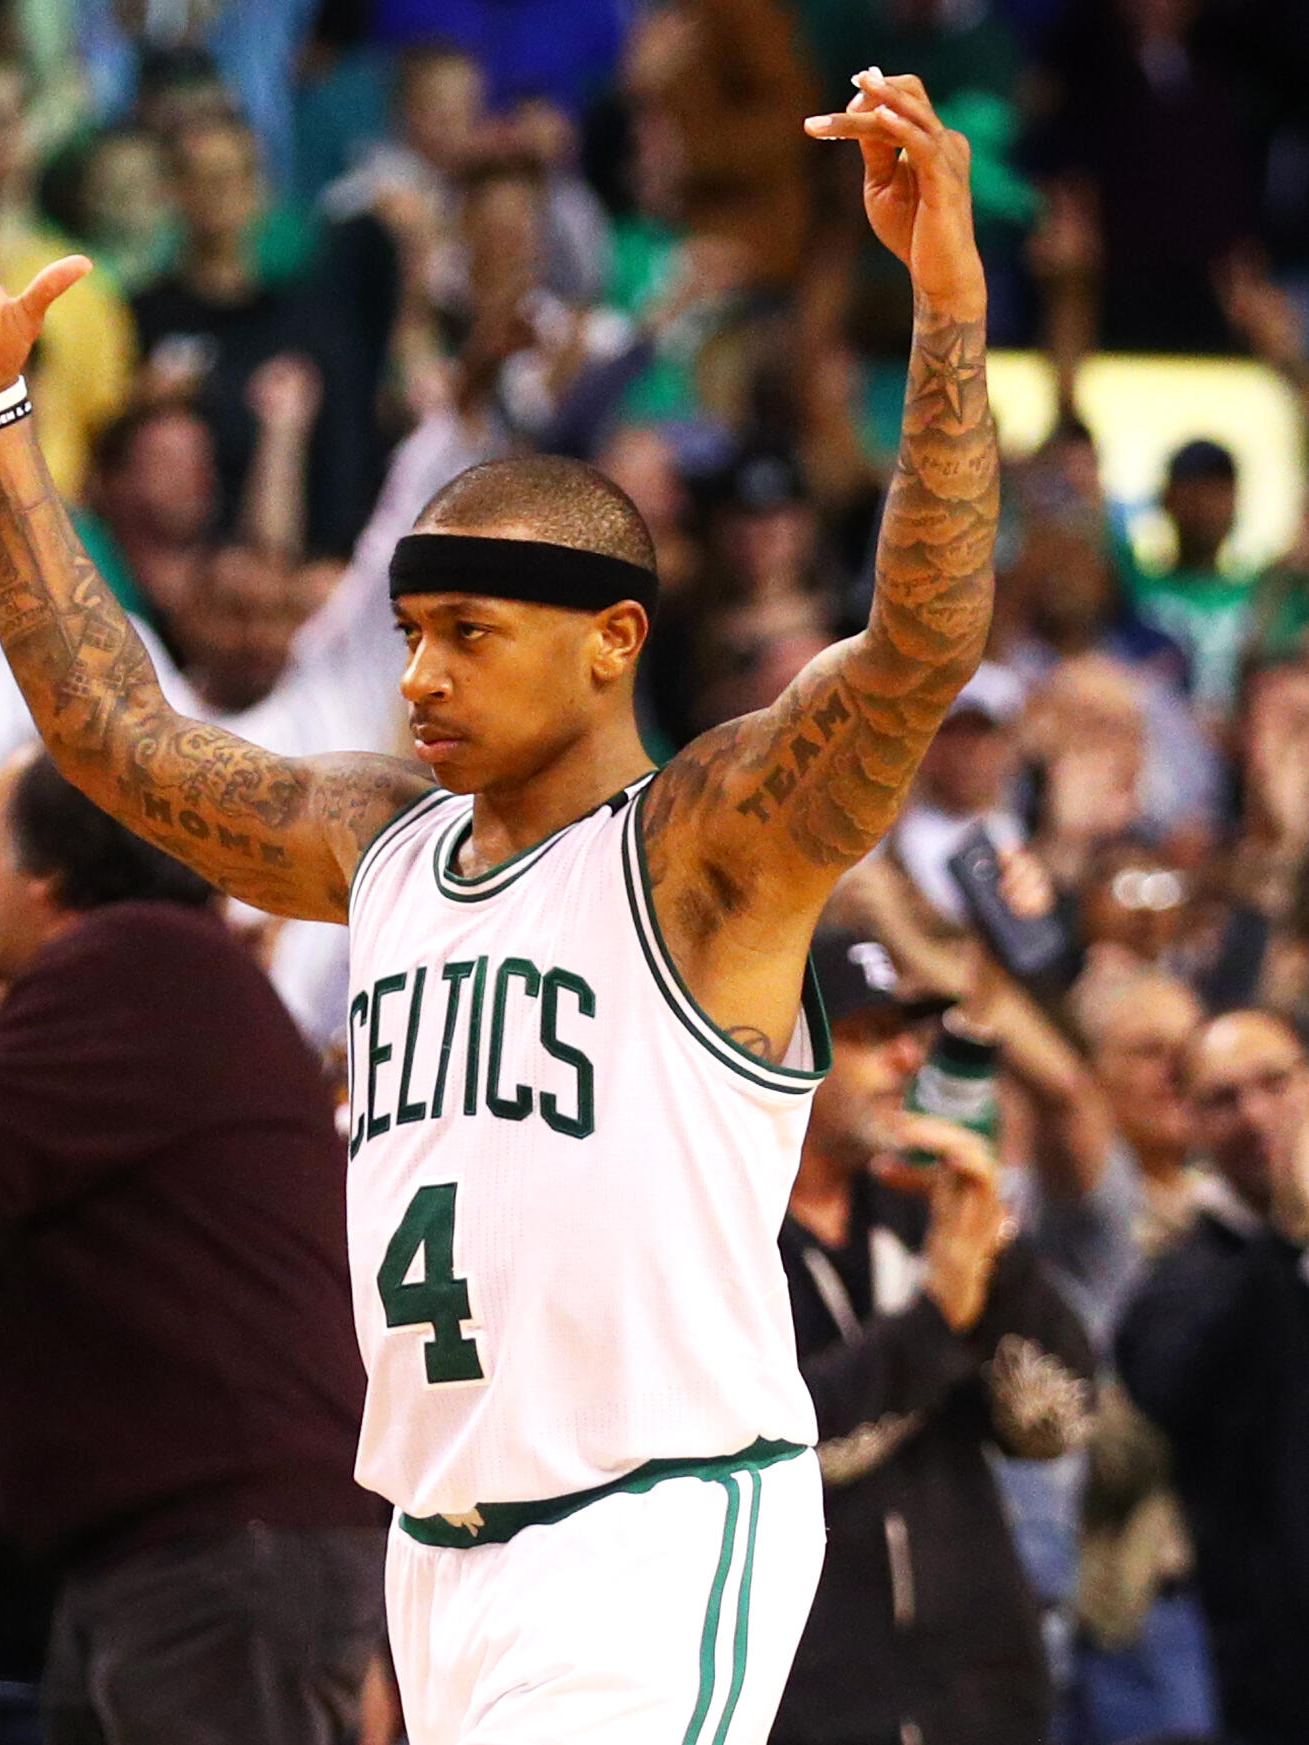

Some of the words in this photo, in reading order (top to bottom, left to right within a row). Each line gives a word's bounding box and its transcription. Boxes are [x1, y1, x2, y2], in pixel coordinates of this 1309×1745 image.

[143, 792, 293, 868] HOME
[735, 688, 851, 823] TEAM
[349, 955, 596, 1162] CELTICS
[376, 1181, 485, 1385] 4
